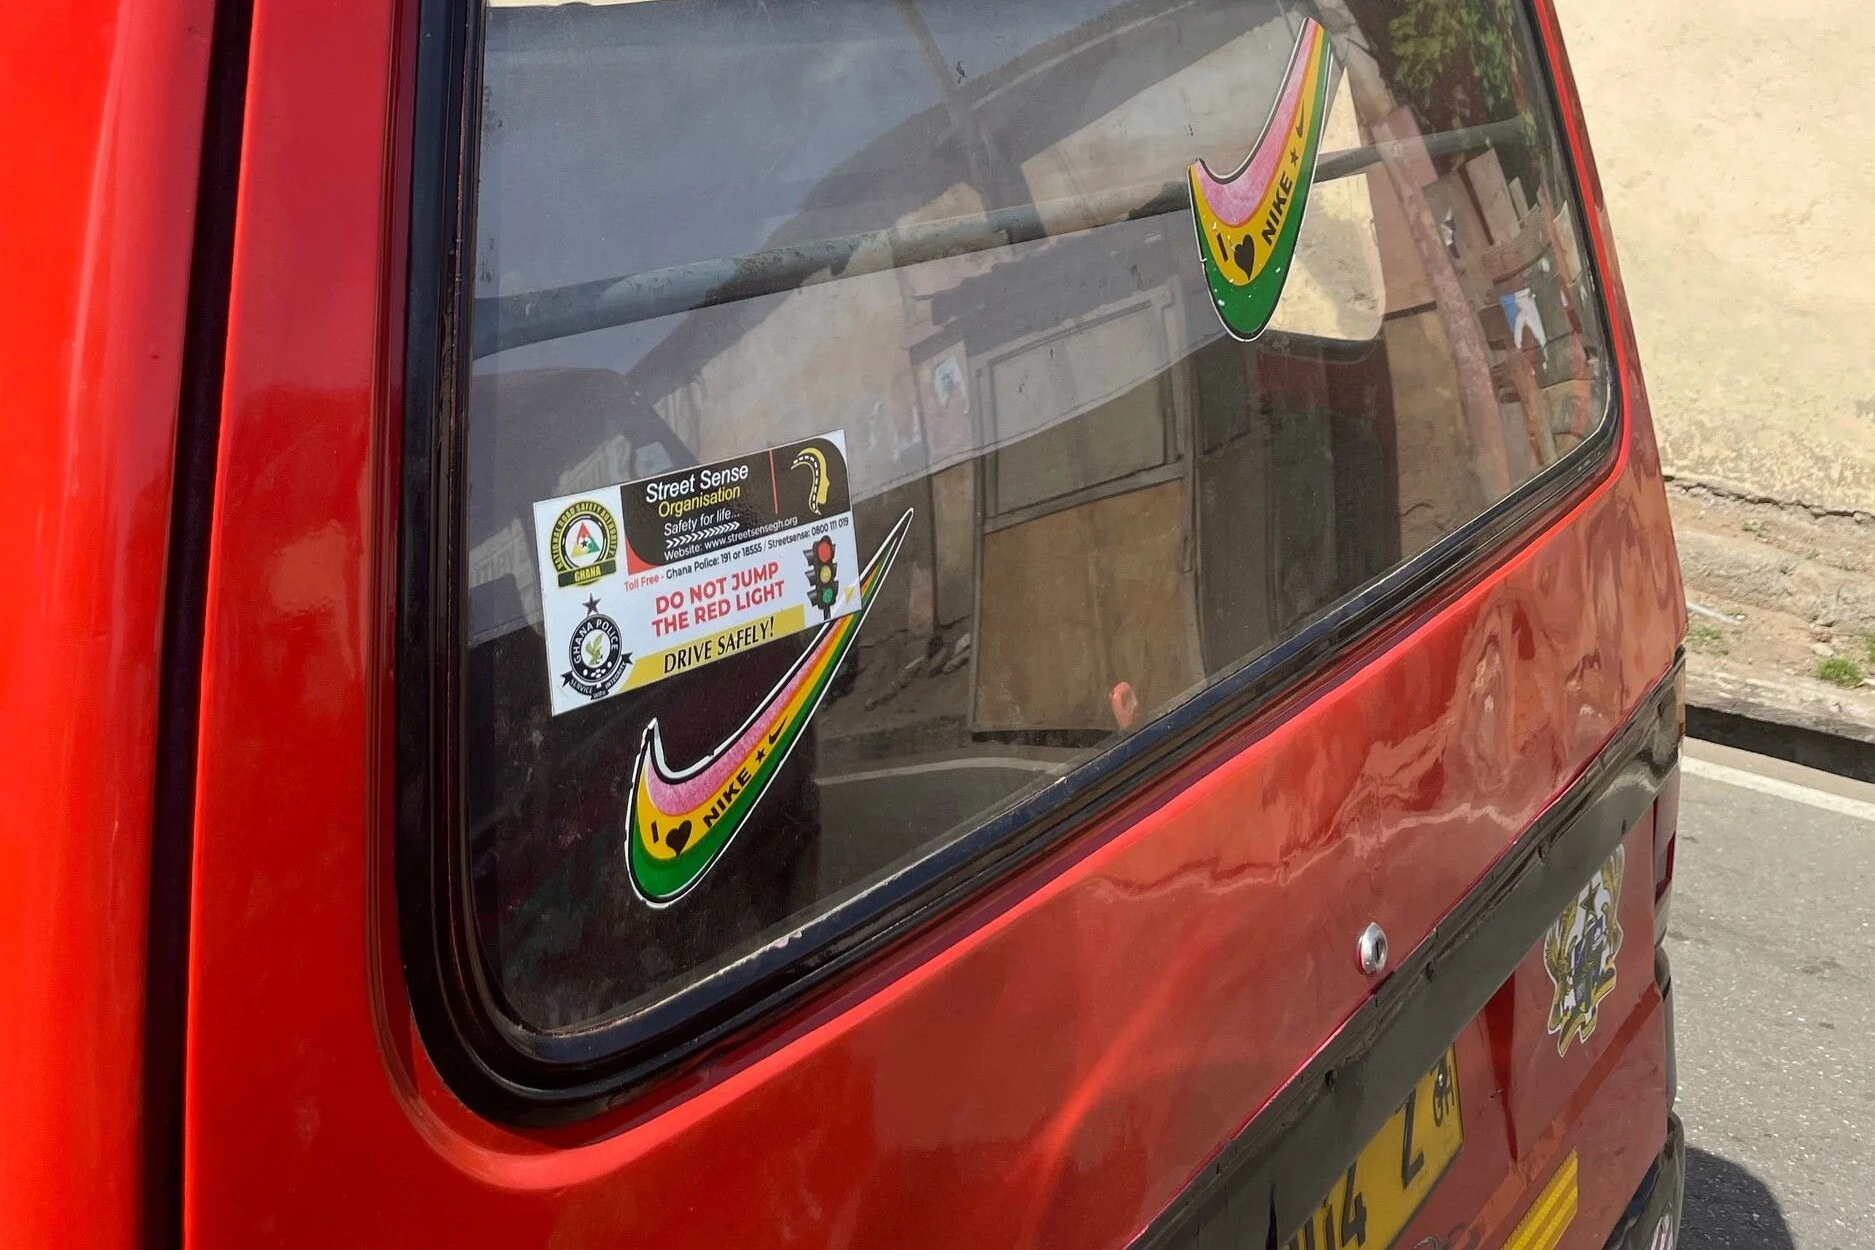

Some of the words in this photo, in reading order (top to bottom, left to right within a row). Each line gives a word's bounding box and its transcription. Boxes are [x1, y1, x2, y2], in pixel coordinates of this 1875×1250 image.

[1216, 232, 1229, 262] I
[1261, 171, 1293, 247] NIKE
[645, 473, 695, 503] Street
[700, 465, 749, 490] Sense
[659, 485, 741, 518] Organisation
[558, 507, 576, 527] ROAD
[576, 502, 601, 514] SAFETY
[600, 510, 617, 556] AUTHORITY
[664, 516, 698, 536] Safety
[700, 513, 715, 527] for
[716, 507, 740, 523] life...
[664, 544, 702, 561] Website:
[704, 516, 798, 549] www.streetsensegh.org
[574, 565, 602, 582] GHANA
[624, 577, 639, 591] Toll
[641, 574, 660, 587] Free
[666, 566, 692, 579] Ghana
[694, 557, 720, 572] Police:
[720, 552, 731, 563] 191
[733, 550, 741, 559] or
[742, 543, 763, 557] 18555
[768, 531, 811, 549] Streetsense:
[812, 524, 828, 536] 0800
[838, 517, 849, 528] 019
[652, 611, 689, 637] THE
[694, 598, 731, 625] RED
[736, 580, 785, 611] LIGHT
[655, 590, 685, 615] DO
[689, 577, 727, 604] NOT
[732, 561, 779, 591] JUMP
[572, 621, 594, 664] GHANA
[596, 618, 619, 651] POLICE
[664, 640, 712, 674] DRIVE
[717, 616, 775, 656] SAFELY!
[651, 820, 660, 844] I
[703, 767, 752, 829] NIKE
